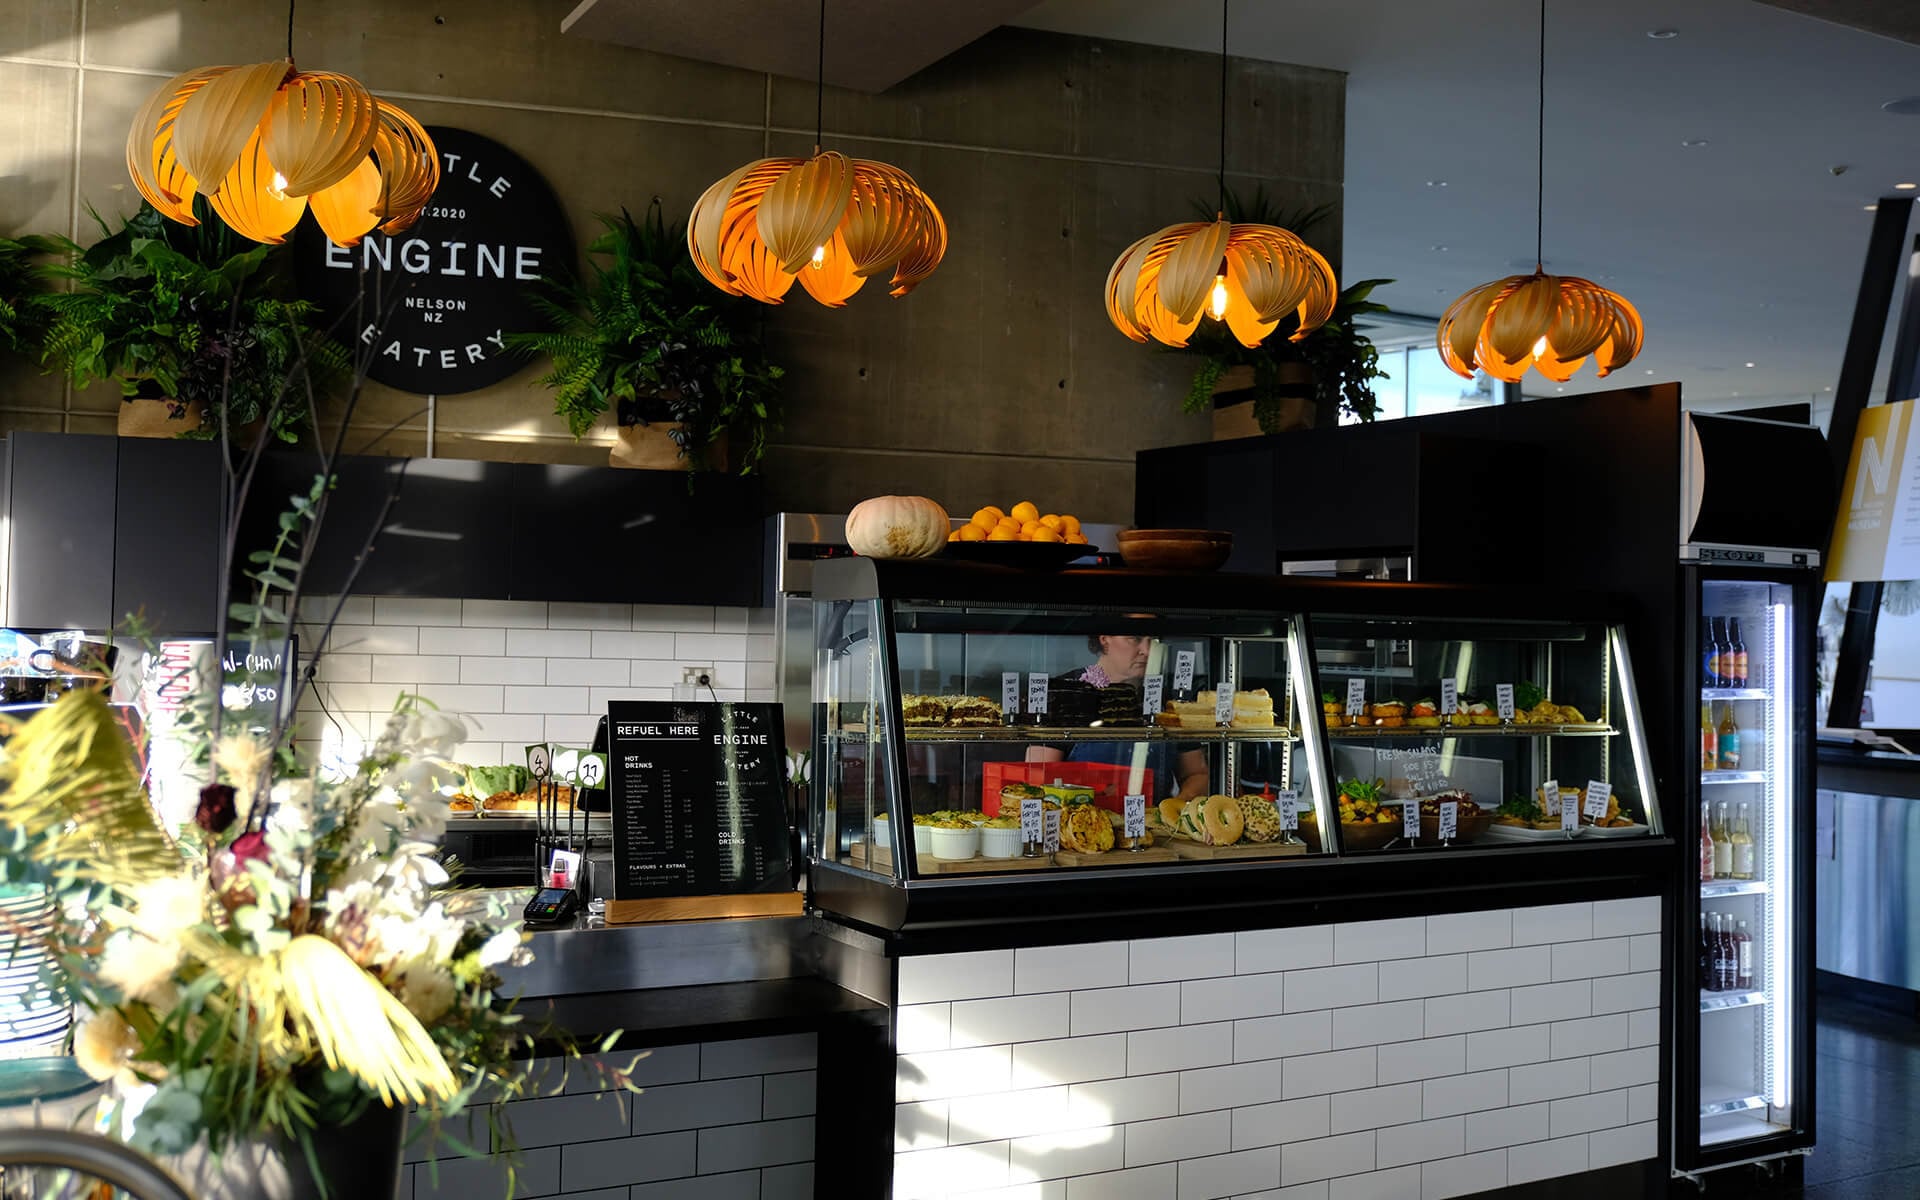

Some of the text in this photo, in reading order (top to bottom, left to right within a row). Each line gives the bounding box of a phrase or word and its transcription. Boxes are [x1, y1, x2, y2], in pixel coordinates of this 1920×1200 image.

[325, 236, 543, 280] ENGINE
[405, 297, 466, 311] NELSON
[424, 312, 443, 323] NZ
[361, 324, 506, 369] EATERY
[1700, 549, 1764, 562] SKOPE
[617, 726, 699, 735] REFUEL HERE
[713, 734, 768, 745] ENGINE
[583, 764, 598, 778] 11
